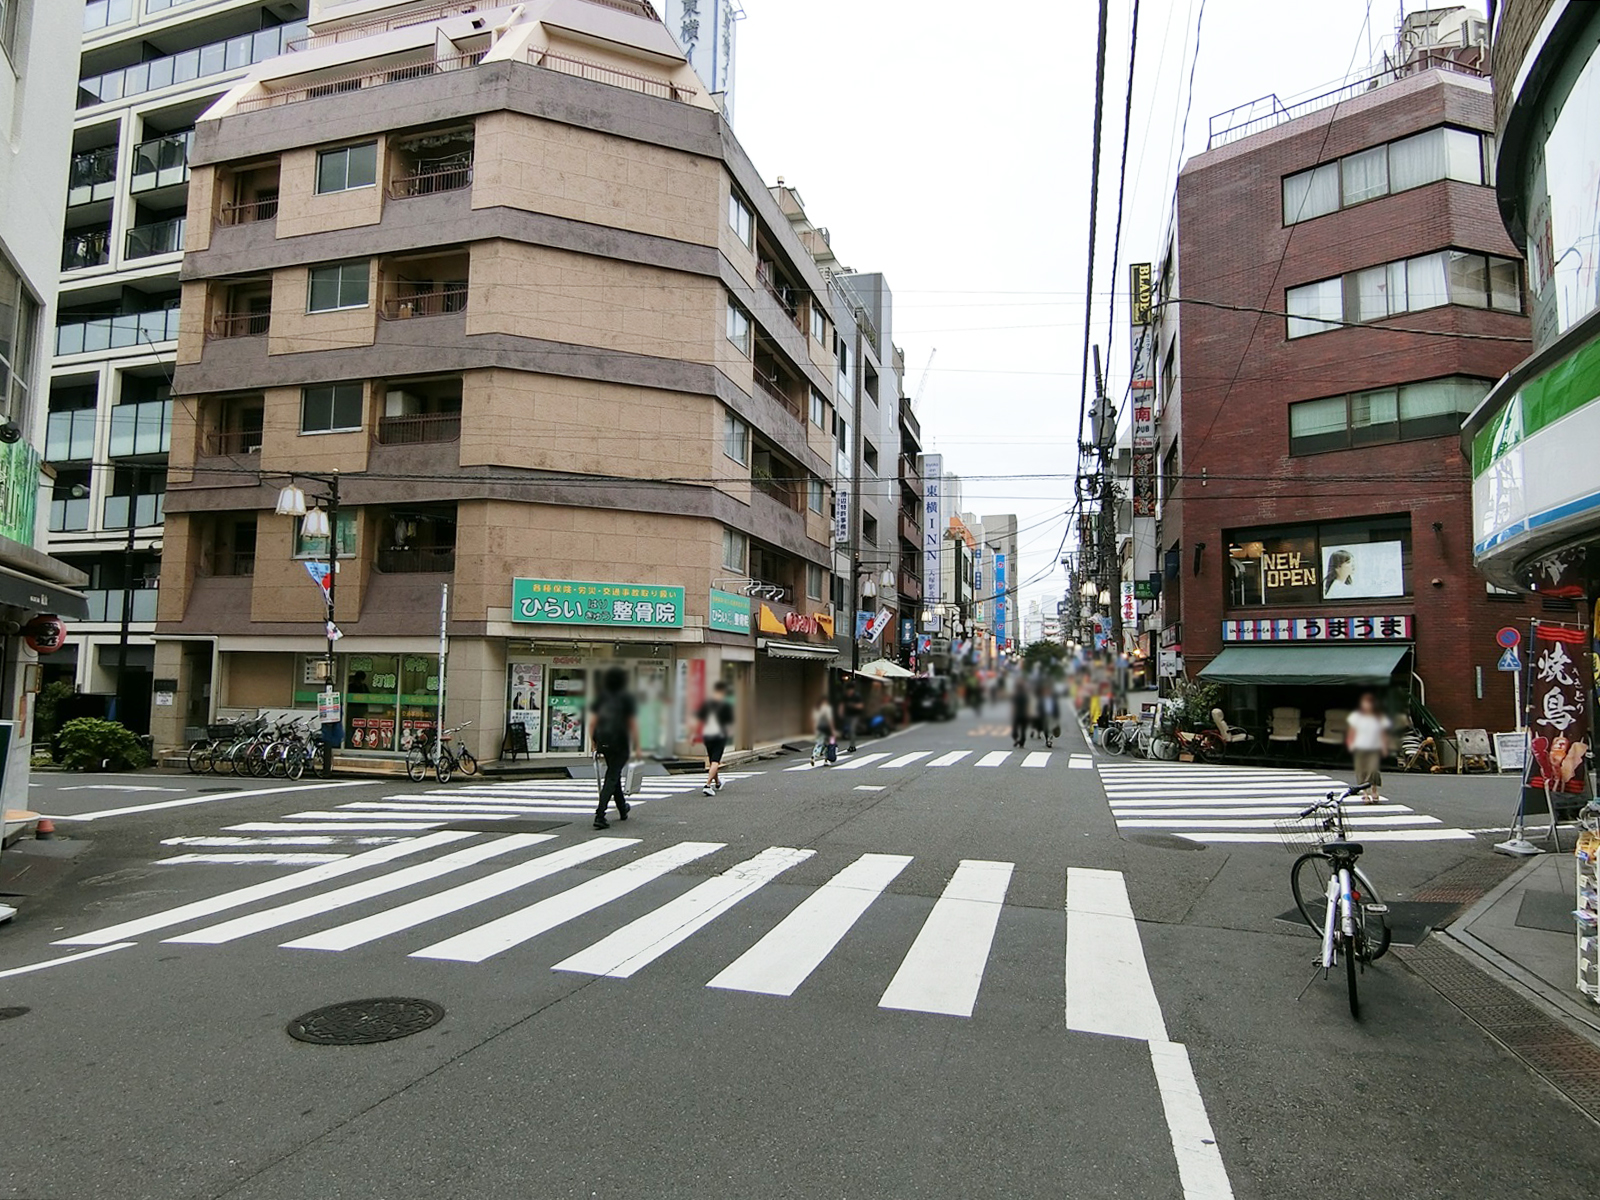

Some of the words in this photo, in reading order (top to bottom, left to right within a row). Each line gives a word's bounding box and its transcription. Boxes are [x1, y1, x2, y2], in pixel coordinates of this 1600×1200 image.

[680, 0, 700, 65] 東横イ
[1139, 265, 1150, 312] BLADE
[1134, 407, 1151, 422] 南
[1263, 552, 1300, 570] NEW
[1267, 568, 1316, 588] OPEN
[520, 597, 583, 619] ひらい
[612, 600, 676, 624] 整骨院
[1303, 618, 1402, 637] うまうま
[1537, 641, 1576, 731] 焼鳥
[1571, 667, 1586, 715] やきとり
